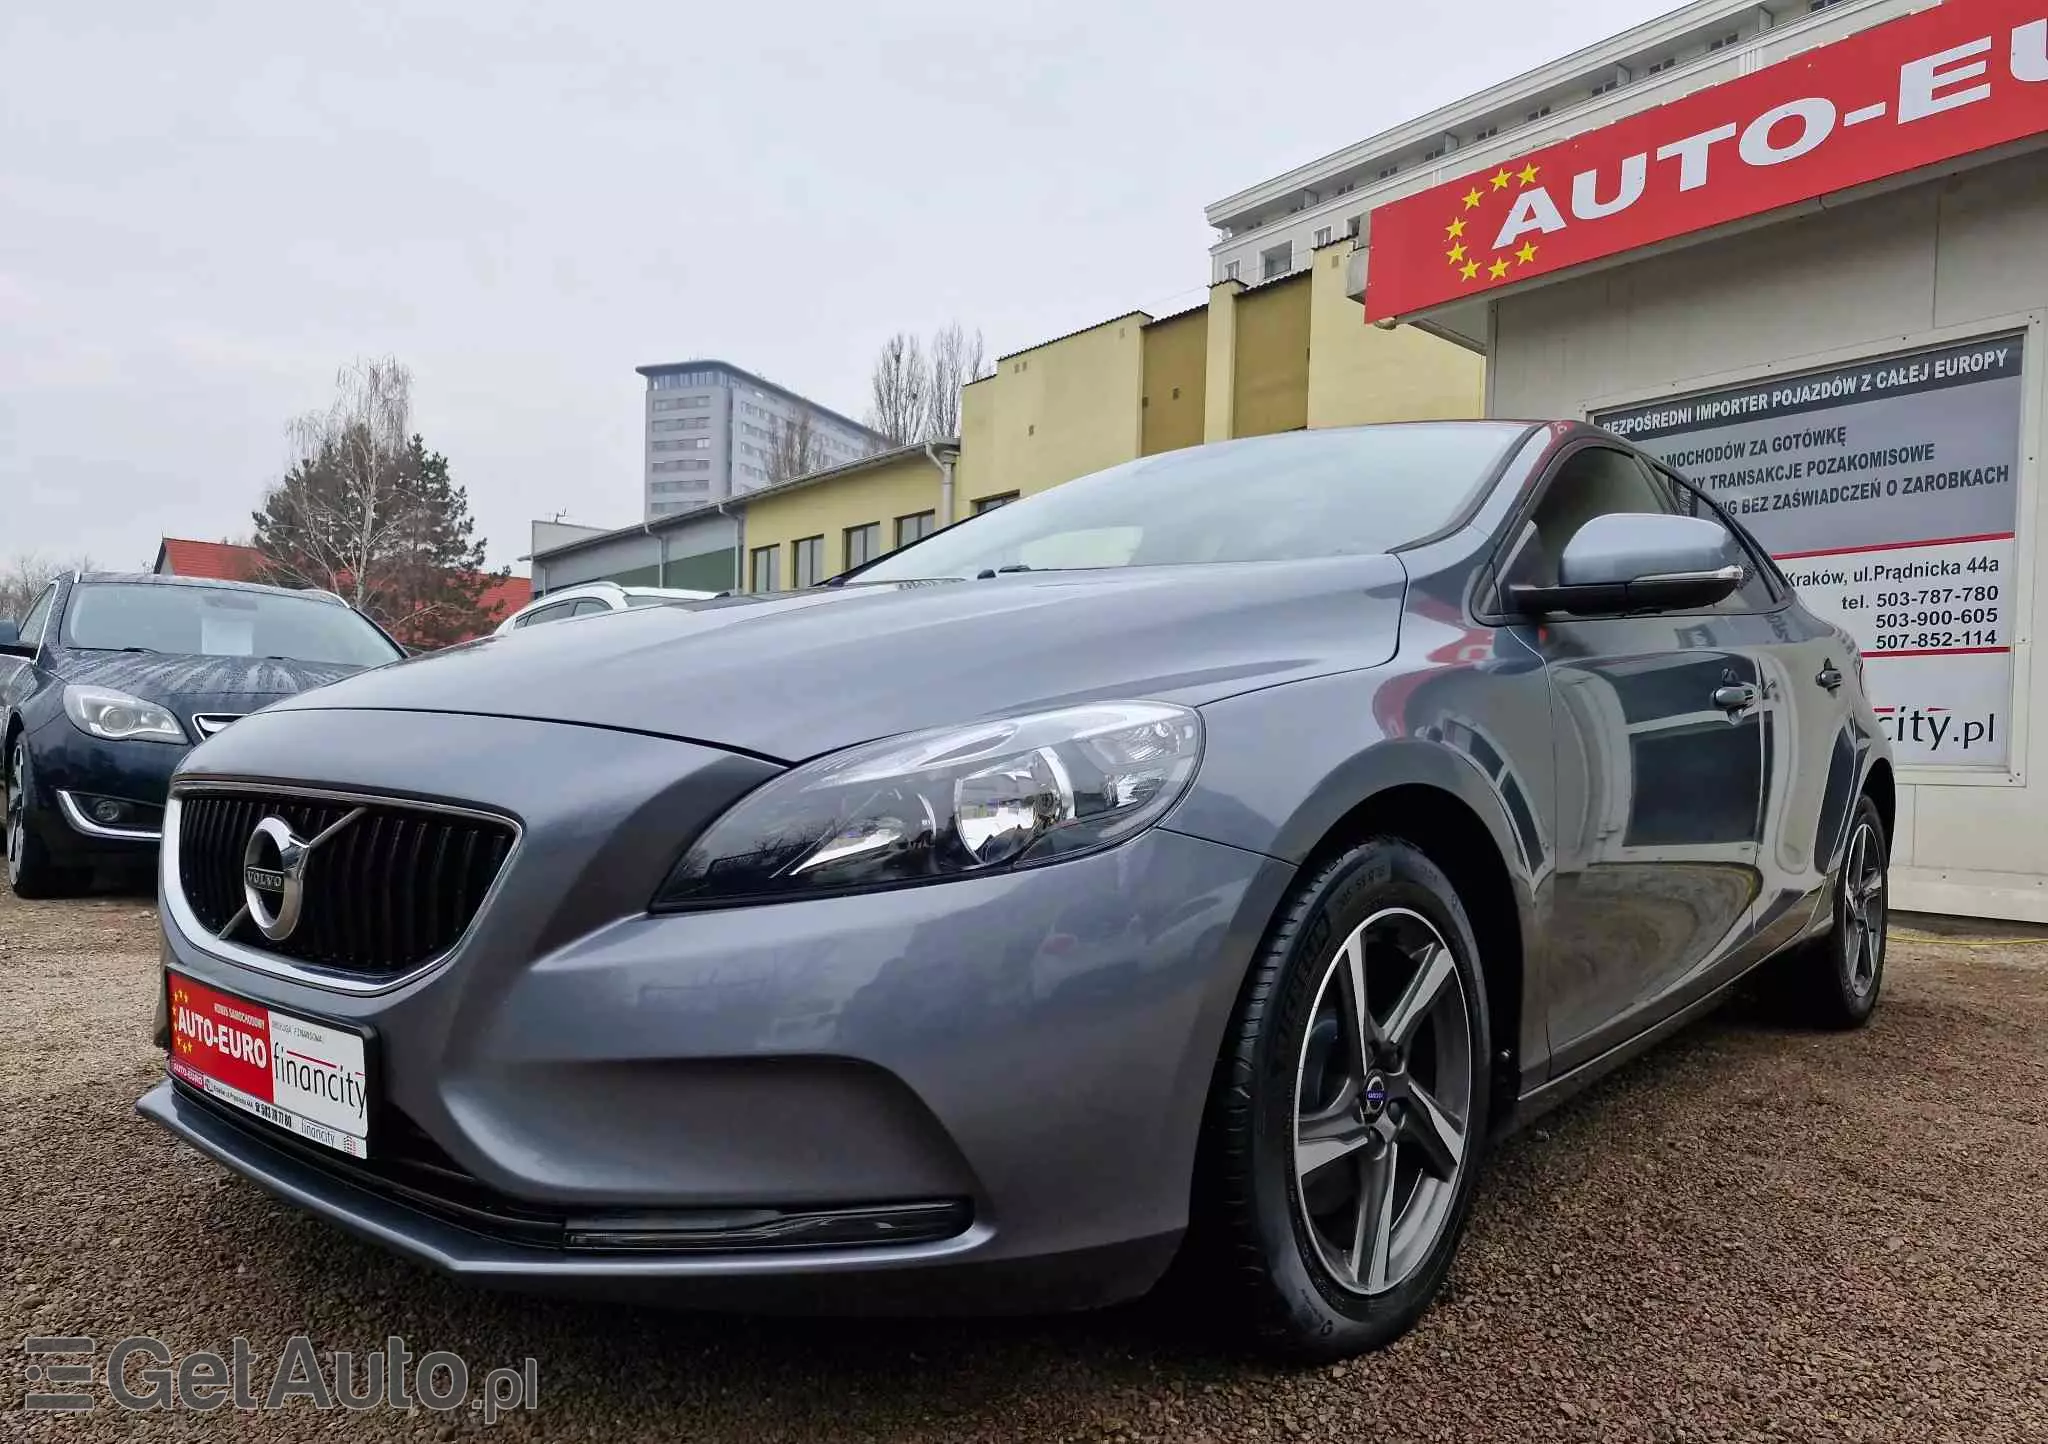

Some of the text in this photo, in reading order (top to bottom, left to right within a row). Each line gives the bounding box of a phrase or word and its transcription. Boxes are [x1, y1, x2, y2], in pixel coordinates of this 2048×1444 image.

[1602, 348, 2008, 434] BEZPOŚREDNI IMPORTER POJAZDÓW Z CAŁEJ EUROPY
[1660, 426, 1847, 468] MOCHODÓW ZA GOTÓWKĘ
[1710, 463, 1802, 490] TRANSAKCJE
[1807, 443, 1935, 477] POZAKOMISOWE
[1742, 496, 1769, 514] BEZ
[1772, 478, 1881, 511] ZAŚWIADCZEŃ
[1886, 479, 1897, 496] O
[1902, 465, 2009, 495] ZAROBKACH
[1785, 556, 2000, 587] Kraków, ul.Prądnicka 44a
[1841, 586, 1999, 610] tel. 503-787-780
[1875, 607, 1998, 629] 503-900-605
[1875, 630, 1997, 650] 507-852-114
[247, 870, 282, 887] VOLVO
[177, 1006, 267, 1069] AUTO-EURO
[274, 1042, 368, 1119] financity
